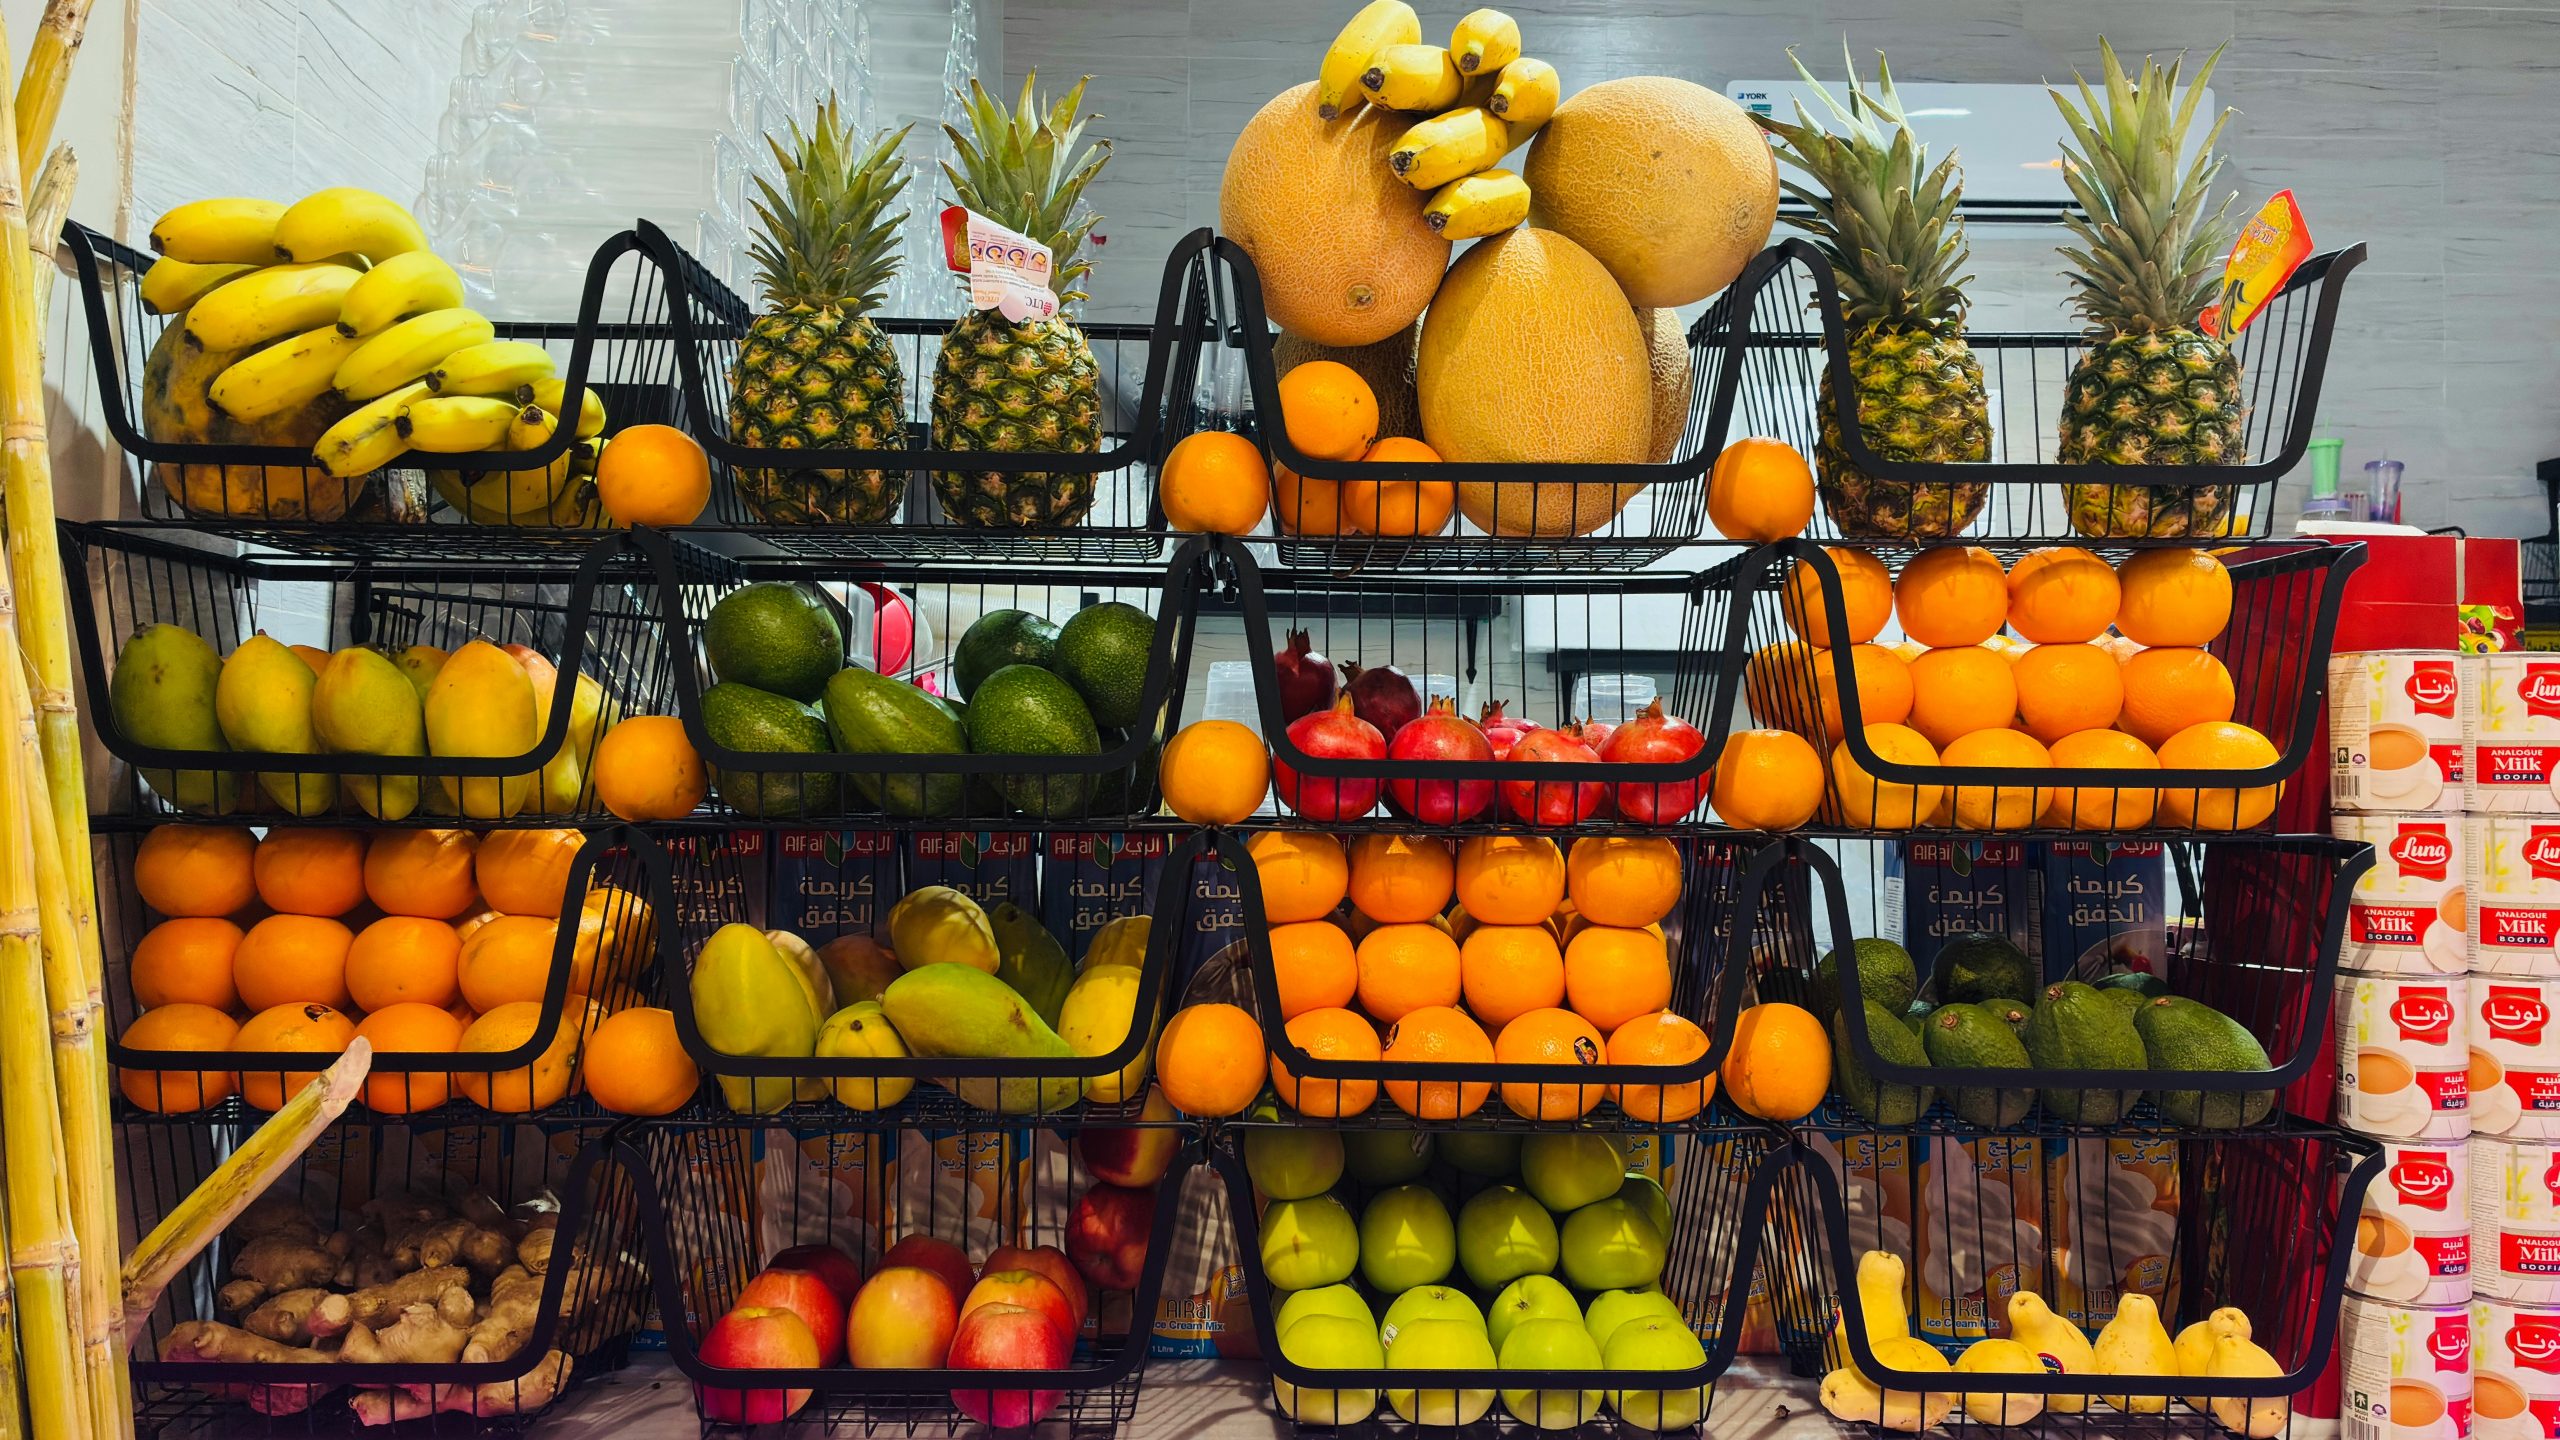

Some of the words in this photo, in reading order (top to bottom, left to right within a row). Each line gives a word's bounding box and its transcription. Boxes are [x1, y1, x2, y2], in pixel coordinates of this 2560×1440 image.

[1745, 92, 1768, 100] YORK
[1025, 296, 1044, 310] UTC
[2414, 677, 2456, 704] لونا
[2525, 675, 2560, 704] Lun
[2491, 749, 2543, 757] ANALOGUE
[2494, 757, 2542, 771] Milk
[856, 835, 890, 854] الي
[2396, 837, 2447, 865] Luna
[799, 874, 874, 901] كريمة
[1069, 876, 1143, 903] كريمة
[1196, 880, 1241, 903] يمة
[2067, 873, 2145, 900] كريمة
[1928, 883, 2004, 909] كريمة
[798, 904, 873, 928] الخفق
[2068, 902, 2144, 927] الخفق
[2364, 909, 2415, 917] ANALOGUE
[2495, 911, 2547, 919] ANALOGUE
[2367, 916, 2413, 932] Milk
[2498, 919, 2545, 934] Milk
[2368, 933, 2414, 942] BOOFIA
[2499, 936, 2546, 944] BOOFIA
[2400, 1003, 2449, 1031] لونا
[2489, 1003, 2543, 1031] لونا
[2531, 1085, 2560, 1099] ليب
[1627, 1136, 1650, 1154] مز
[2397, 1168, 2449, 1196] لونا
[2516, 1238, 2560, 1247] ANALOGU
[2437, 1250, 2467, 1264] حليب
[1941, 1297, 1987, 1317] ARai
[2068, 1311, 2084, 1320] Ice
[1169, 1320, 1203, 1330] Cream
[1205, 1320, 1225, 1331] Mix
[1926, 1318, 1942, 1327] Ice
[1944, 1318, 1978, 1328] Ceam
[2513, 1330, 2560, 1359] ونا
